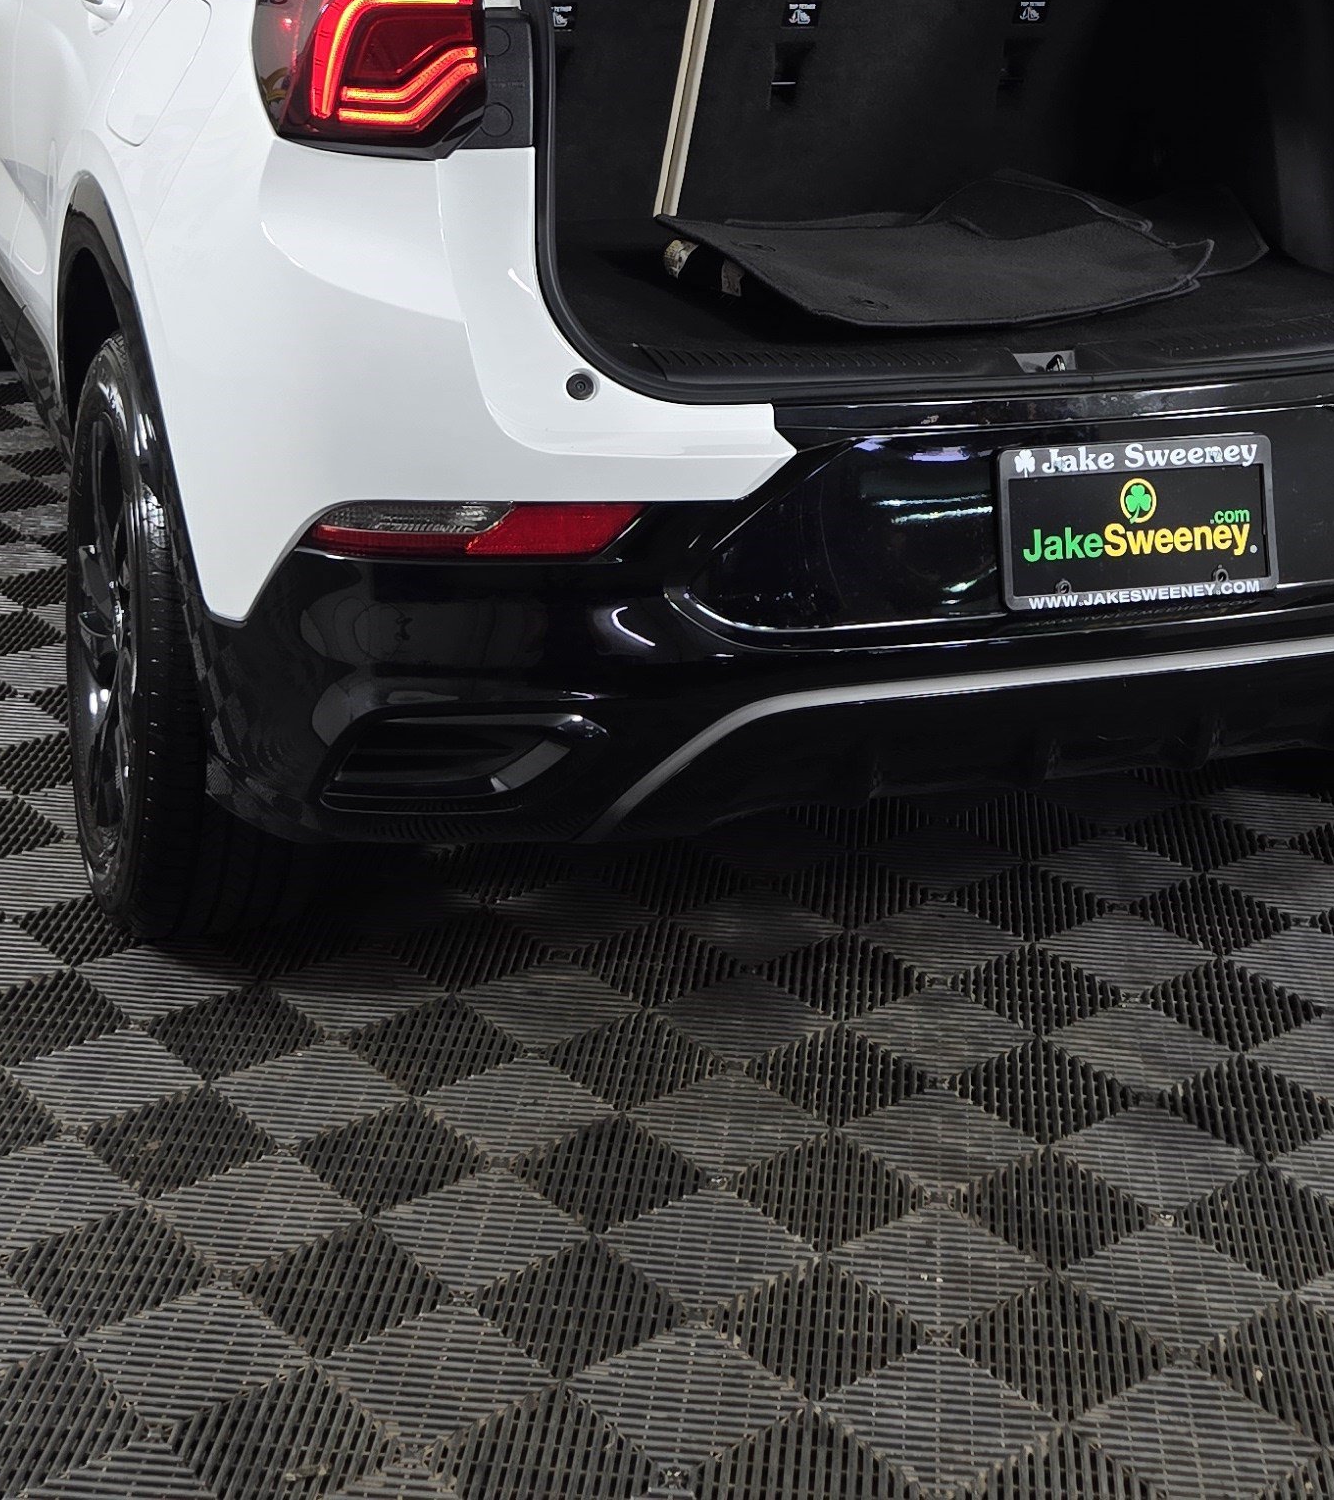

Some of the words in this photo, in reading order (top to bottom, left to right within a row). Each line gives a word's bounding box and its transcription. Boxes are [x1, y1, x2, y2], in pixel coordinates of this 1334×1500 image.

[1041, 446, 1115, 473] Jake
[1124, 443, 1258, 468] Sweeney
[1209, 507, 1250, 524] .com
[1028, 580, 1260, 611] WWW.JAKESWEENEY.COM
